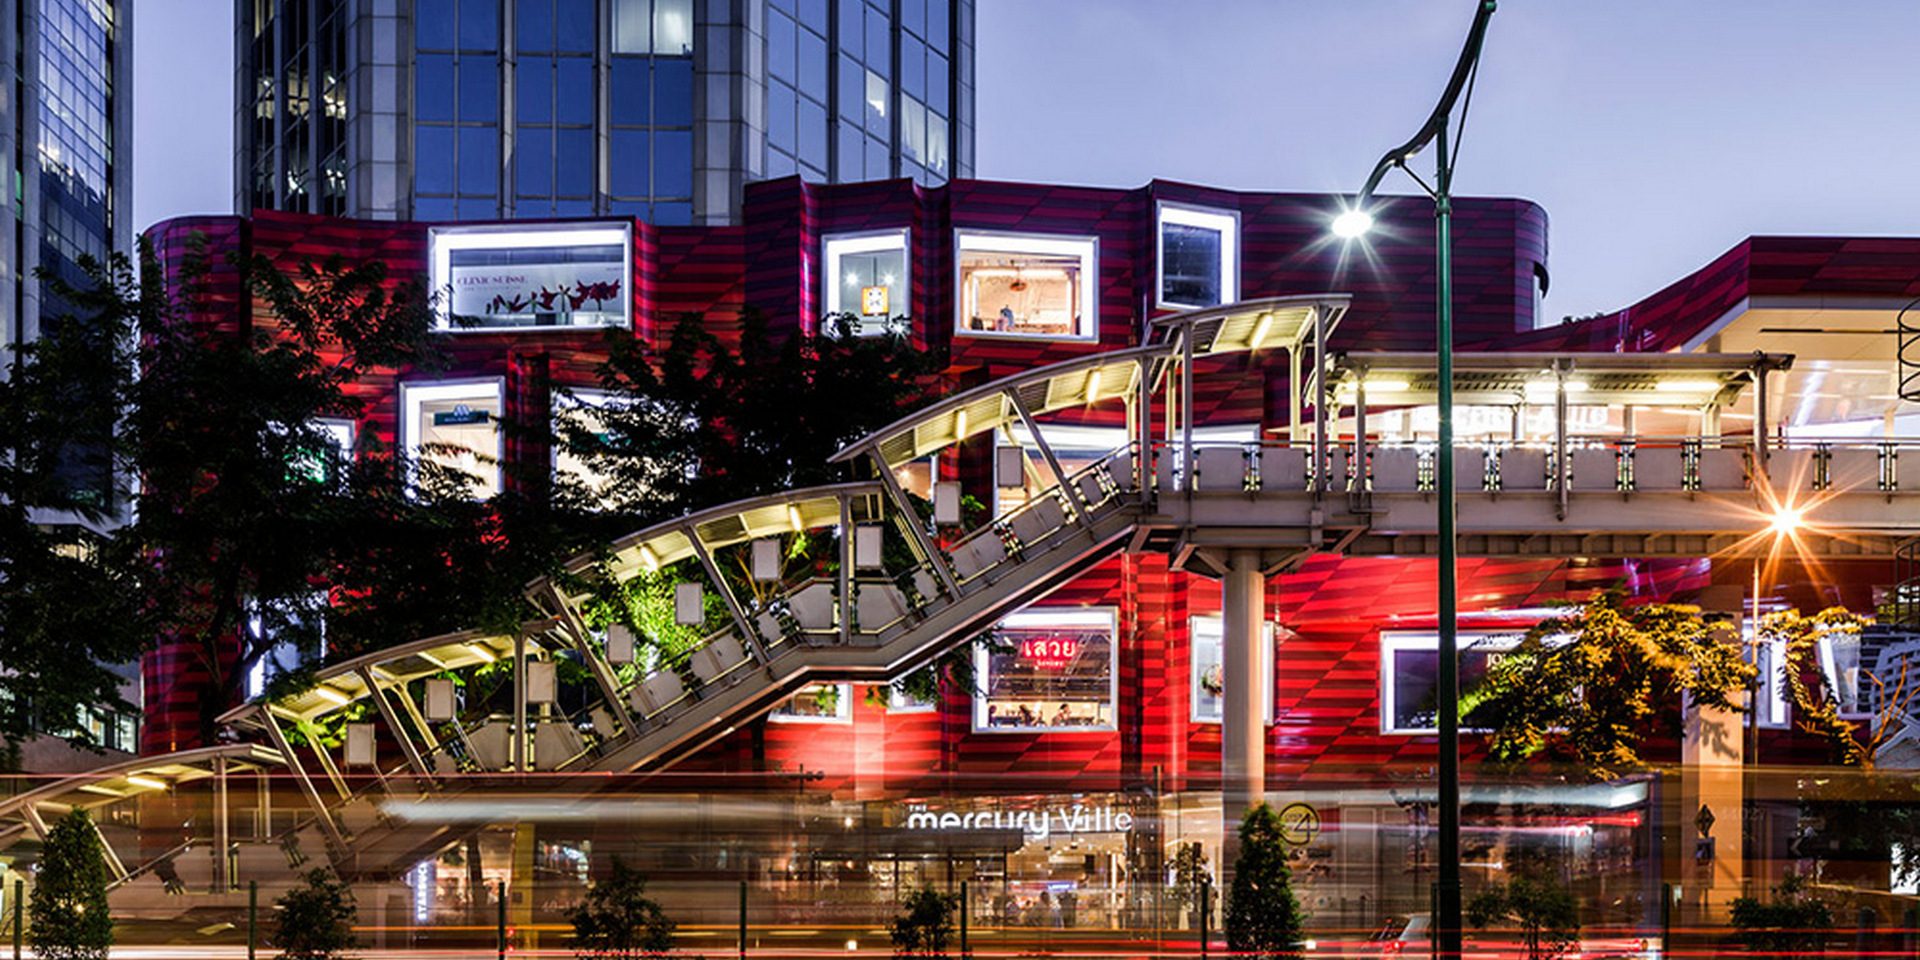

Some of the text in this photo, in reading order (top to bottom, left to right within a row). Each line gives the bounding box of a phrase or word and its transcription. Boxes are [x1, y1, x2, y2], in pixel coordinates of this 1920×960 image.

[456, 276, 489, 285] CLINIC
[1024, 640, 1077, 657] เสวย
[908, 804, 928, 812] THE
[907, 805, 1133, 839] mercury Ville
